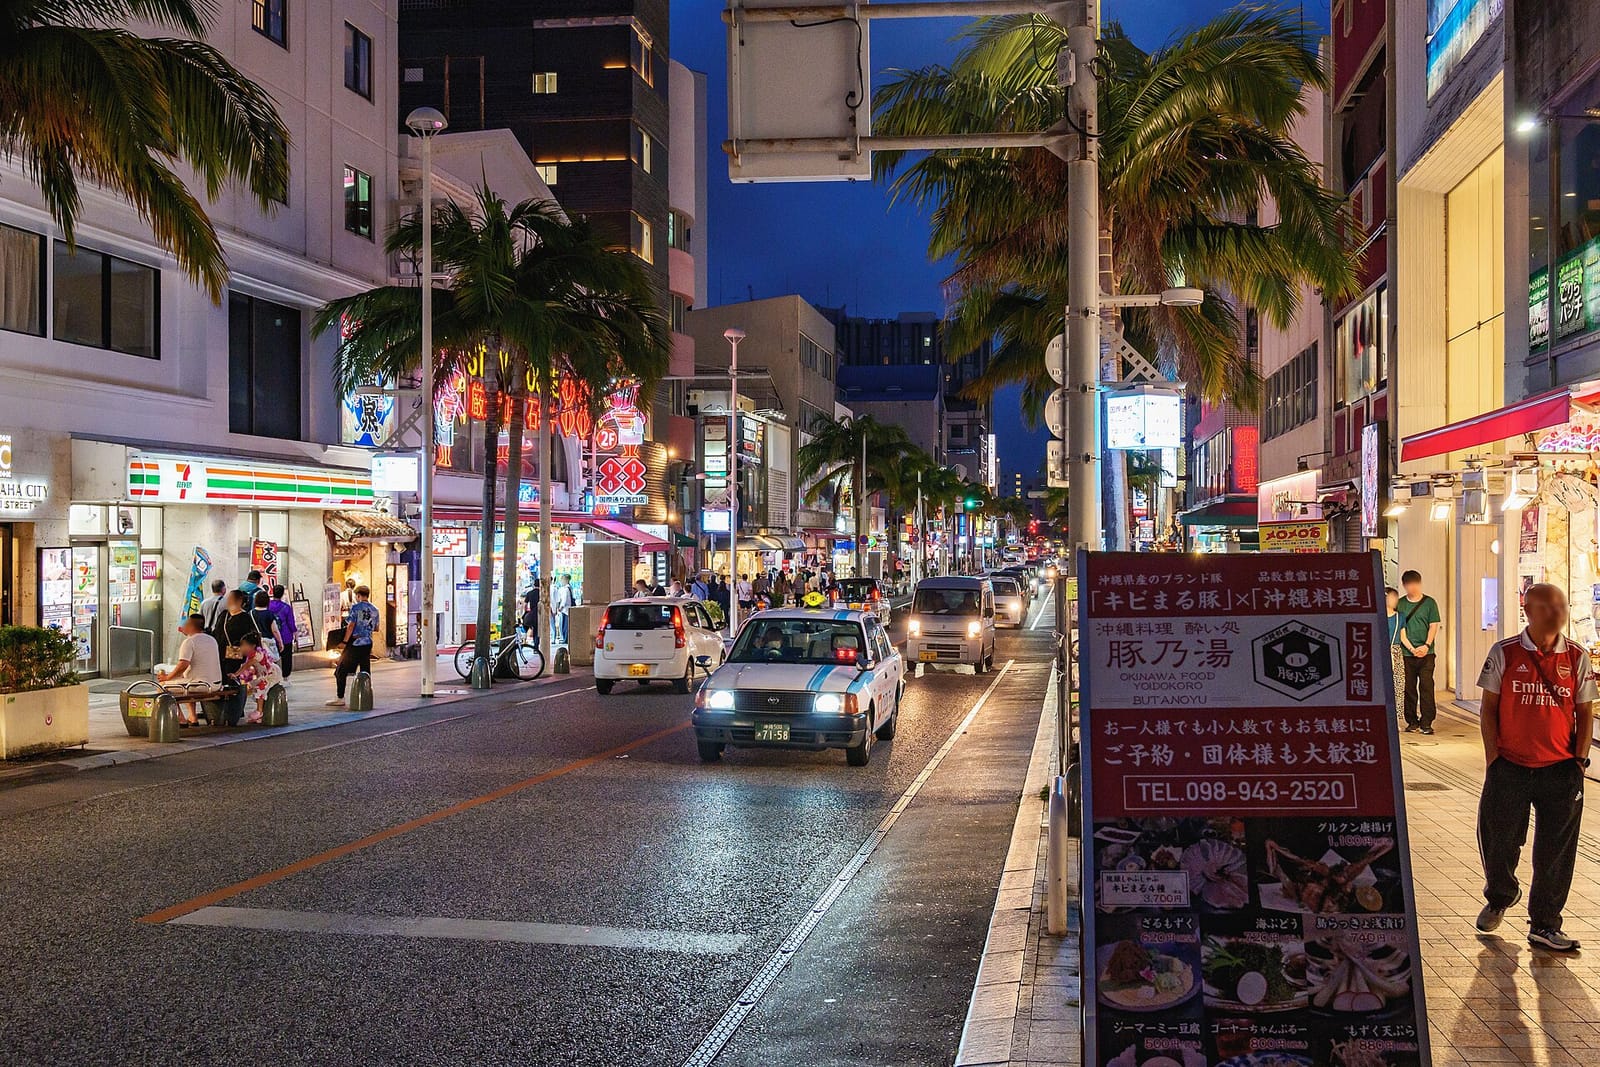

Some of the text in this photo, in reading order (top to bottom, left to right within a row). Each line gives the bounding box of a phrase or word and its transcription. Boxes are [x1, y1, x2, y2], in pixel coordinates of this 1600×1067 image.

[600, 431, 615, 446] 2F
[1236, 427, 1257, 491] 郷土料理
[597, 456, 648, 496] 88
[26, 484, 49, 498] CITY
[4, 500, 33, 510] STREET
[598, 497, 646, 505] 国際通り西口店
[1098, 573, 1223, 586] 沖縄県産のブランド豚
[1257, 570, 1360, 583] 品数豊富にご用意
[1095, 621, 1240, 636] 沖縄料理 酔い処
[1106, 639, 1235, 670] 豚乃湯
[1119, 671, 1216, 681] OKINAWA FOOD
[1133, 681, 1204, 691] YOIDOKORO
[1132, 695, 1208, 706] BUTANOYU
[1521, 695, 1559, 707] FLY BETTE
[762, 730, 789, 741] 71-58
[1137, 781, 1345, 804] TEL.098-943-2520
[1317, 821, 1393, 834] グルクン唐揚げ
[1143, 893, 1182, 904] 3,700円
[1141, 917, 1193, 930] ざるもずく
[1256, 917, 1299, 930] 海ぶどう
[1113, 1021, 1201, 1036] ジーマーミー豆腐
[1210, 1023, 1308, 1036] ゴーヤーちゃんぷるー
[1346, 1023, 1416, 1038] もずく天ぷら
